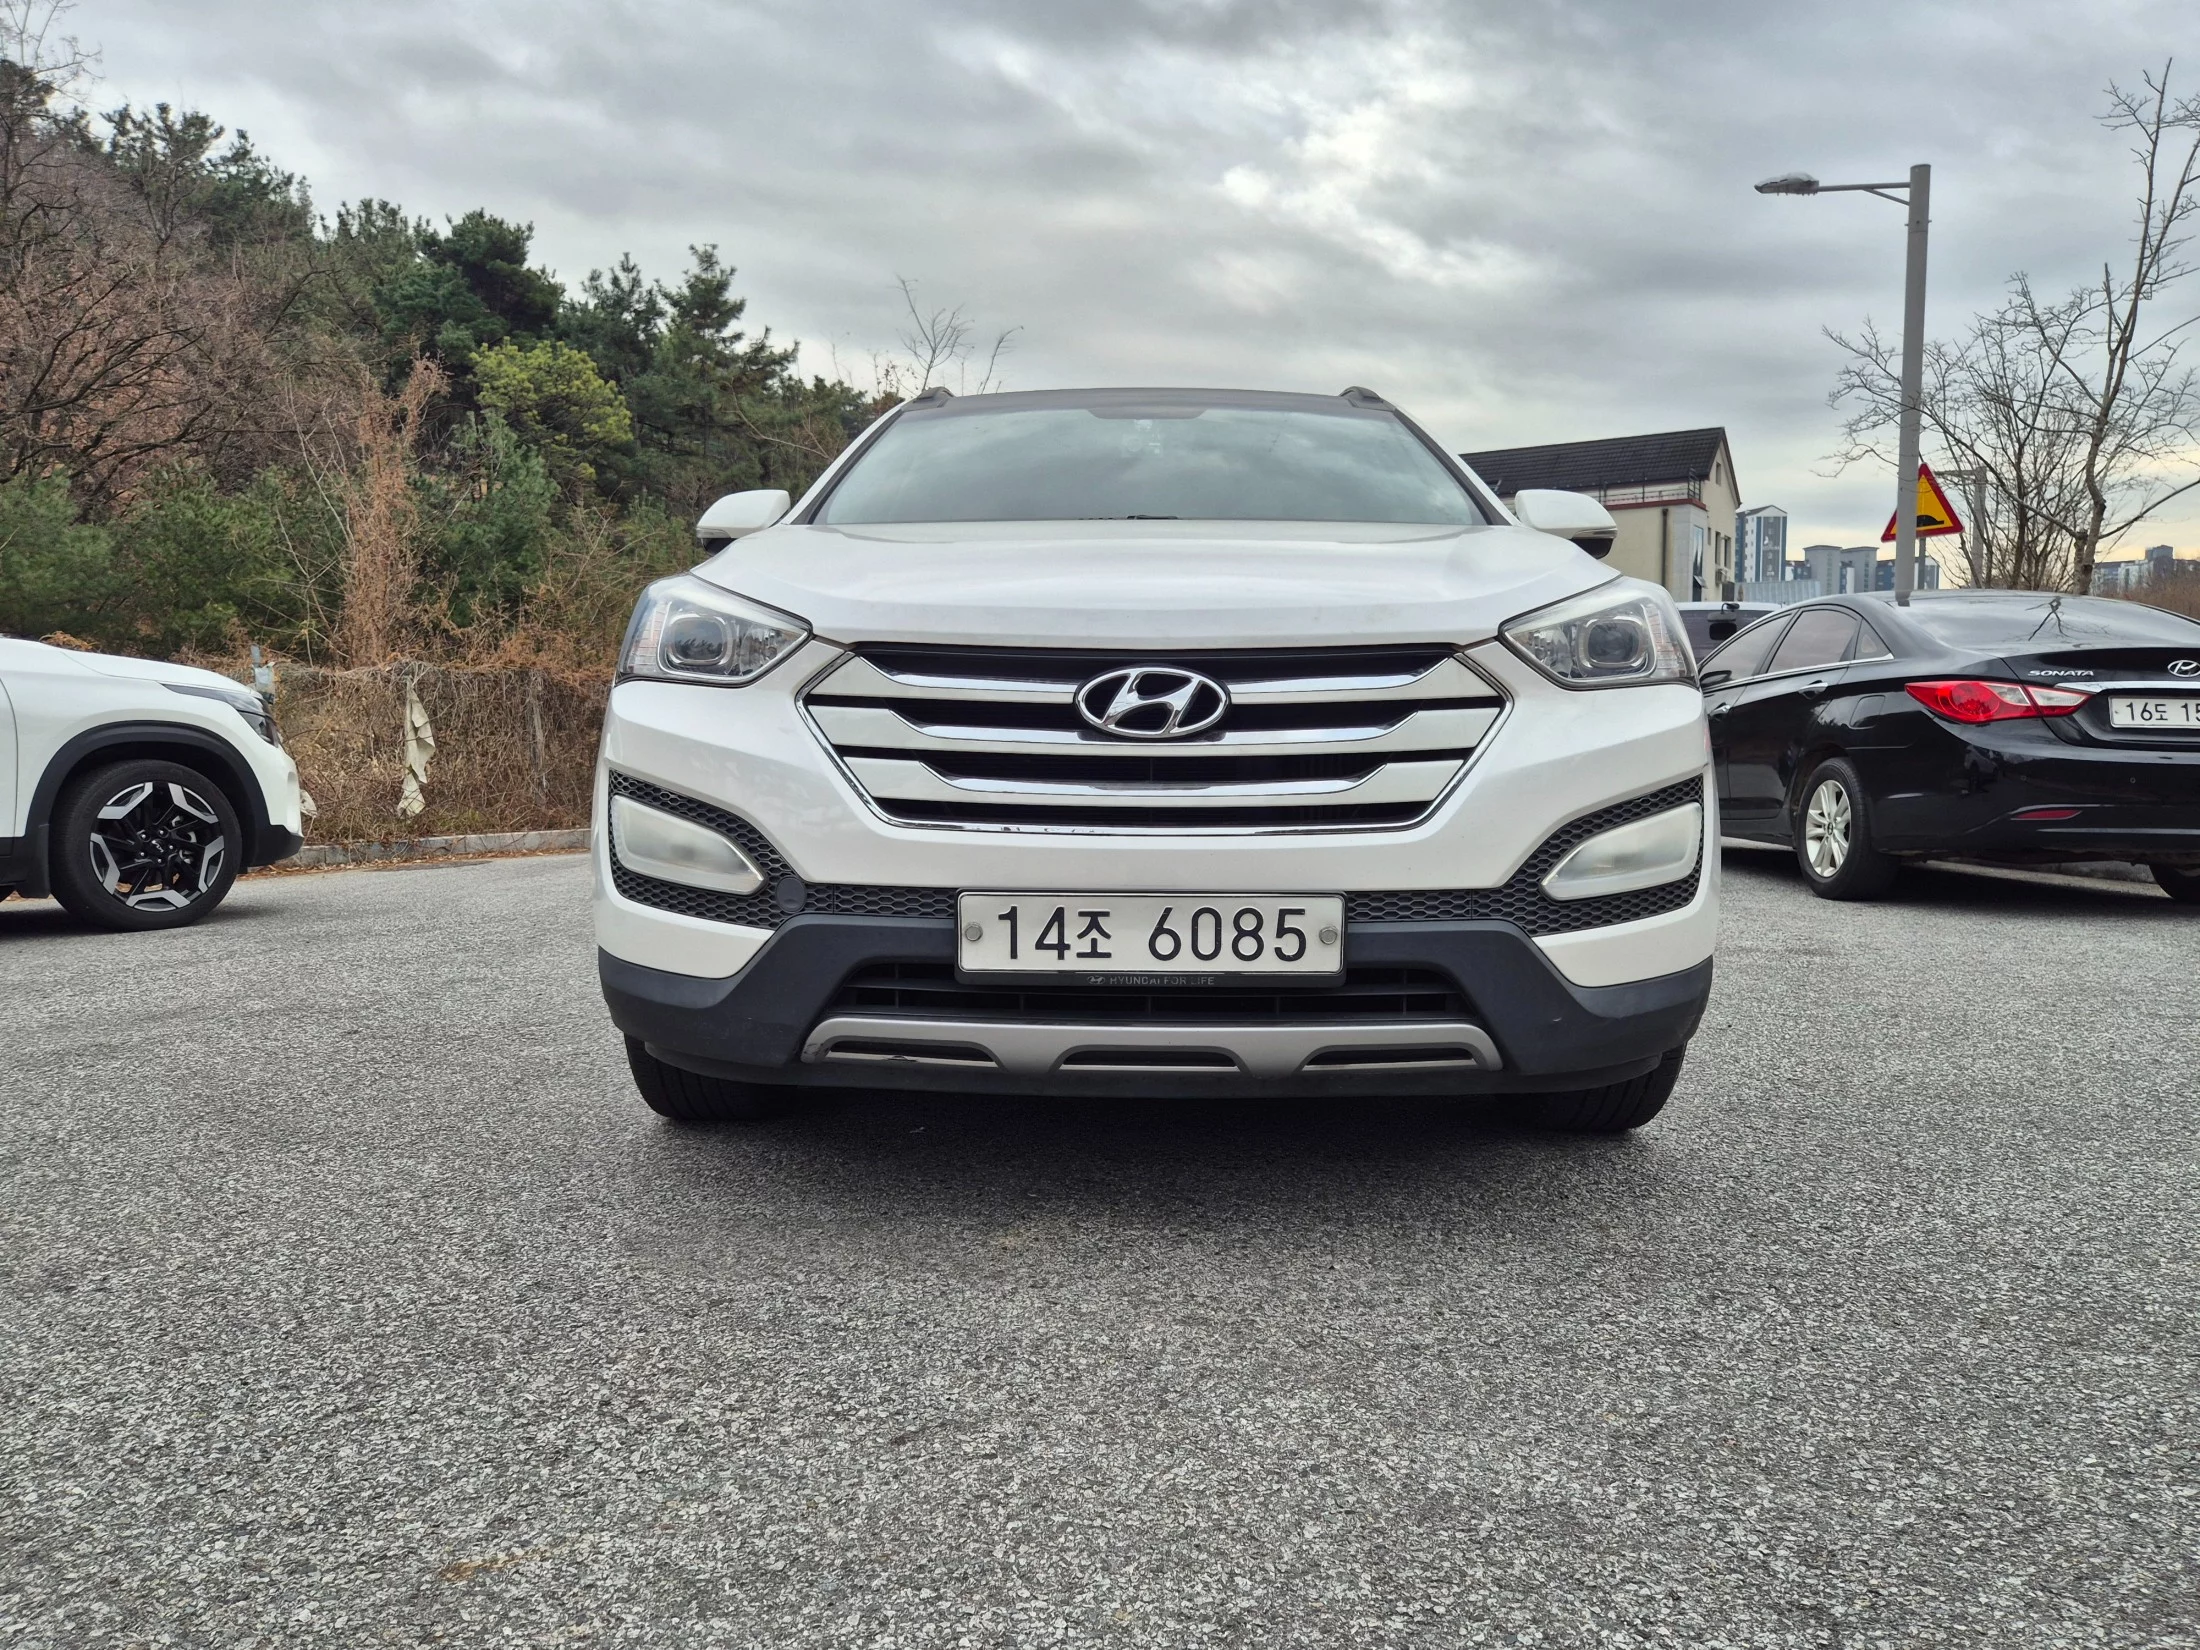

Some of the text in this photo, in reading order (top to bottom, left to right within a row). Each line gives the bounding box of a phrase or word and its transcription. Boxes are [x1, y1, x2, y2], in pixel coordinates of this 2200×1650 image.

[2126, 702, 2168, 721] 16도
[998, 905, 1306, 962] 14조 6085
[1164, 976, 1187, 985] FOR
